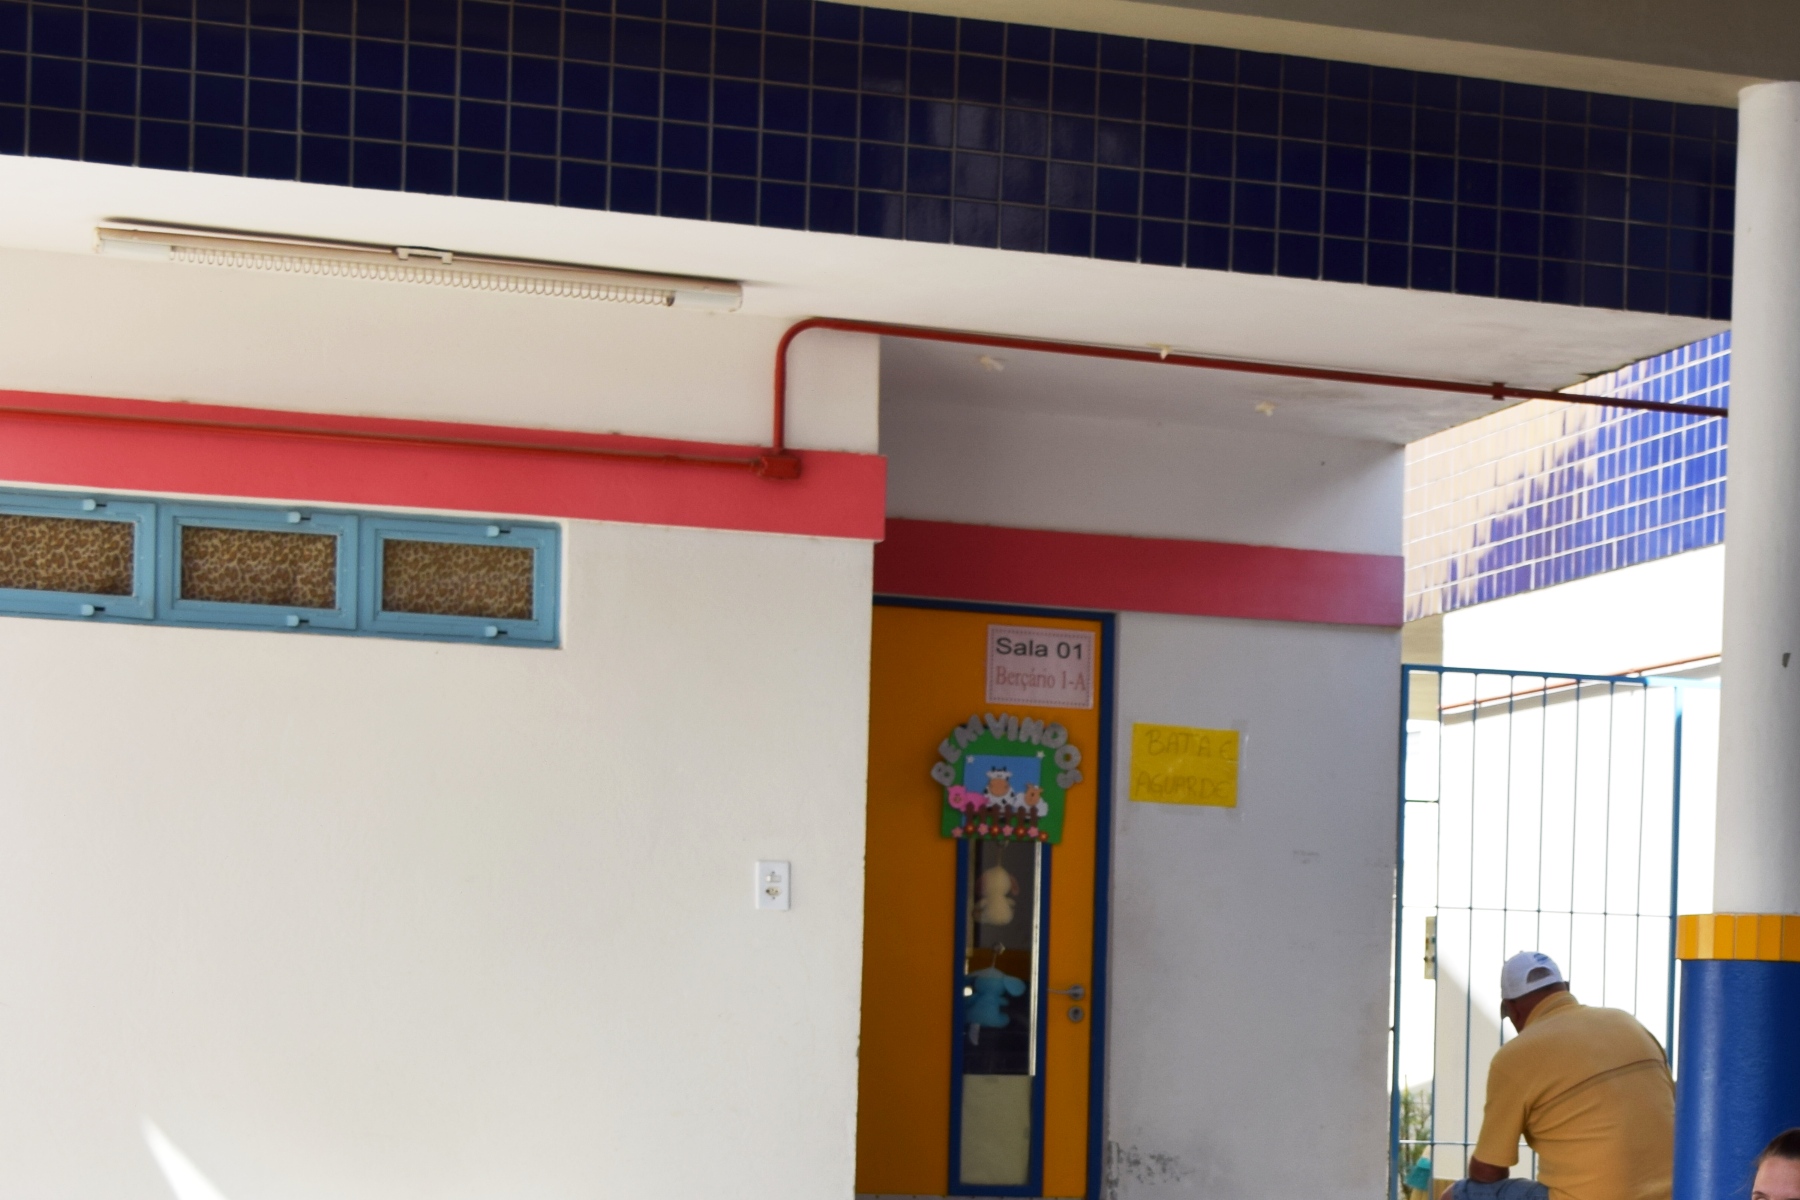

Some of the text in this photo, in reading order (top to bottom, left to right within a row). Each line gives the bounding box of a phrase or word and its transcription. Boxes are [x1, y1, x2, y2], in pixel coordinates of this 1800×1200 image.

[996, 637, 1083, 660] Sala 01
[996, 666, 1056, 691] Berçário
[931, 713, 1082, 789] BEM VINDOS
[1145, 728, 1211, 757] BATA
[1134, 770, 1232, 799] AGUARDE
